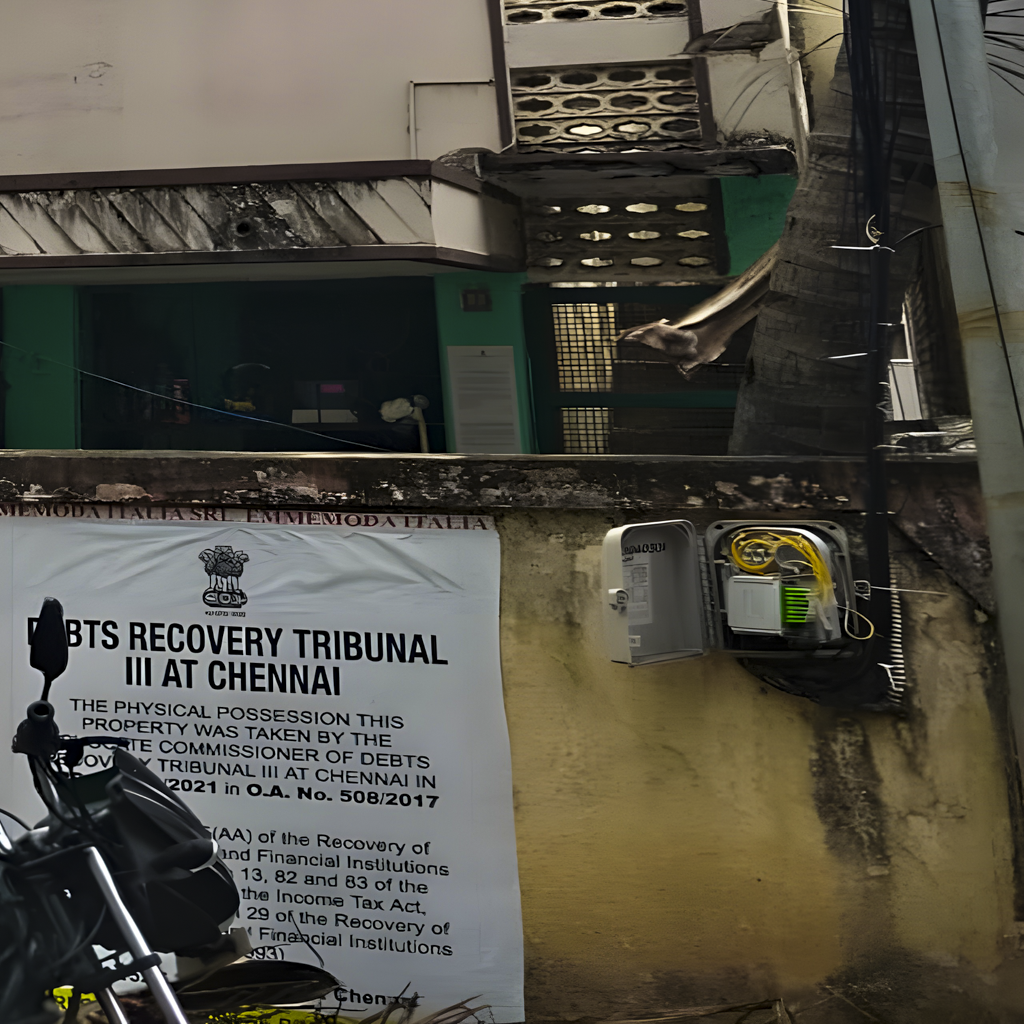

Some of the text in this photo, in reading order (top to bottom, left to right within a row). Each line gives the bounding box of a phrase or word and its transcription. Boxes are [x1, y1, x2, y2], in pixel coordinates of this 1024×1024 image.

[247, 509, 396, 528] EMMEMODA
[27, 617, 449, 665] DBTS RECOVERY TRIBUNAL
[126, 656, 341, 696] III AT CHENNAI
[69, 698, 405, 729] THE PHYSICAL POSSESSION THIS
[82, 717, 392, 748] PROPERTY WAS TAKEN BY THE
[159, 739, 319, 762] COMMISSIONER
[325, 749, 353, 764] OF
[360, 752, 430, 769] DEBTS
[157, 758, 256, 777] TRIBUNAL
[262, 765, 278, 779] III
[284, 767, 309, 780] AT
[315, 768, 408, 787] CHENNAI
[416, 774, 436, 789] IN
[225, 782, 240, 796] in
[246, 783, 291, 799] O.A.
[297, 787, 333, 802] No.
[340, 790, 440, 809] 508/2017
[258, 830, 276, 844] of
[282, 831, 310, 847] the
[317, 834, 406, 857] Recovery
[412, 841, 431, 856] of
[257, 849, 340, 868] Financial
[347, 855, 450, 877] Institutions
[241, 868, 429, 895] 13, 82 and 83 of the
[241, 886, 427, 917] the Income Tax Act,
[247, 906, 451, 937] 29 of the Recovery of
[259, 927, 454, 957] Financial Institutions
